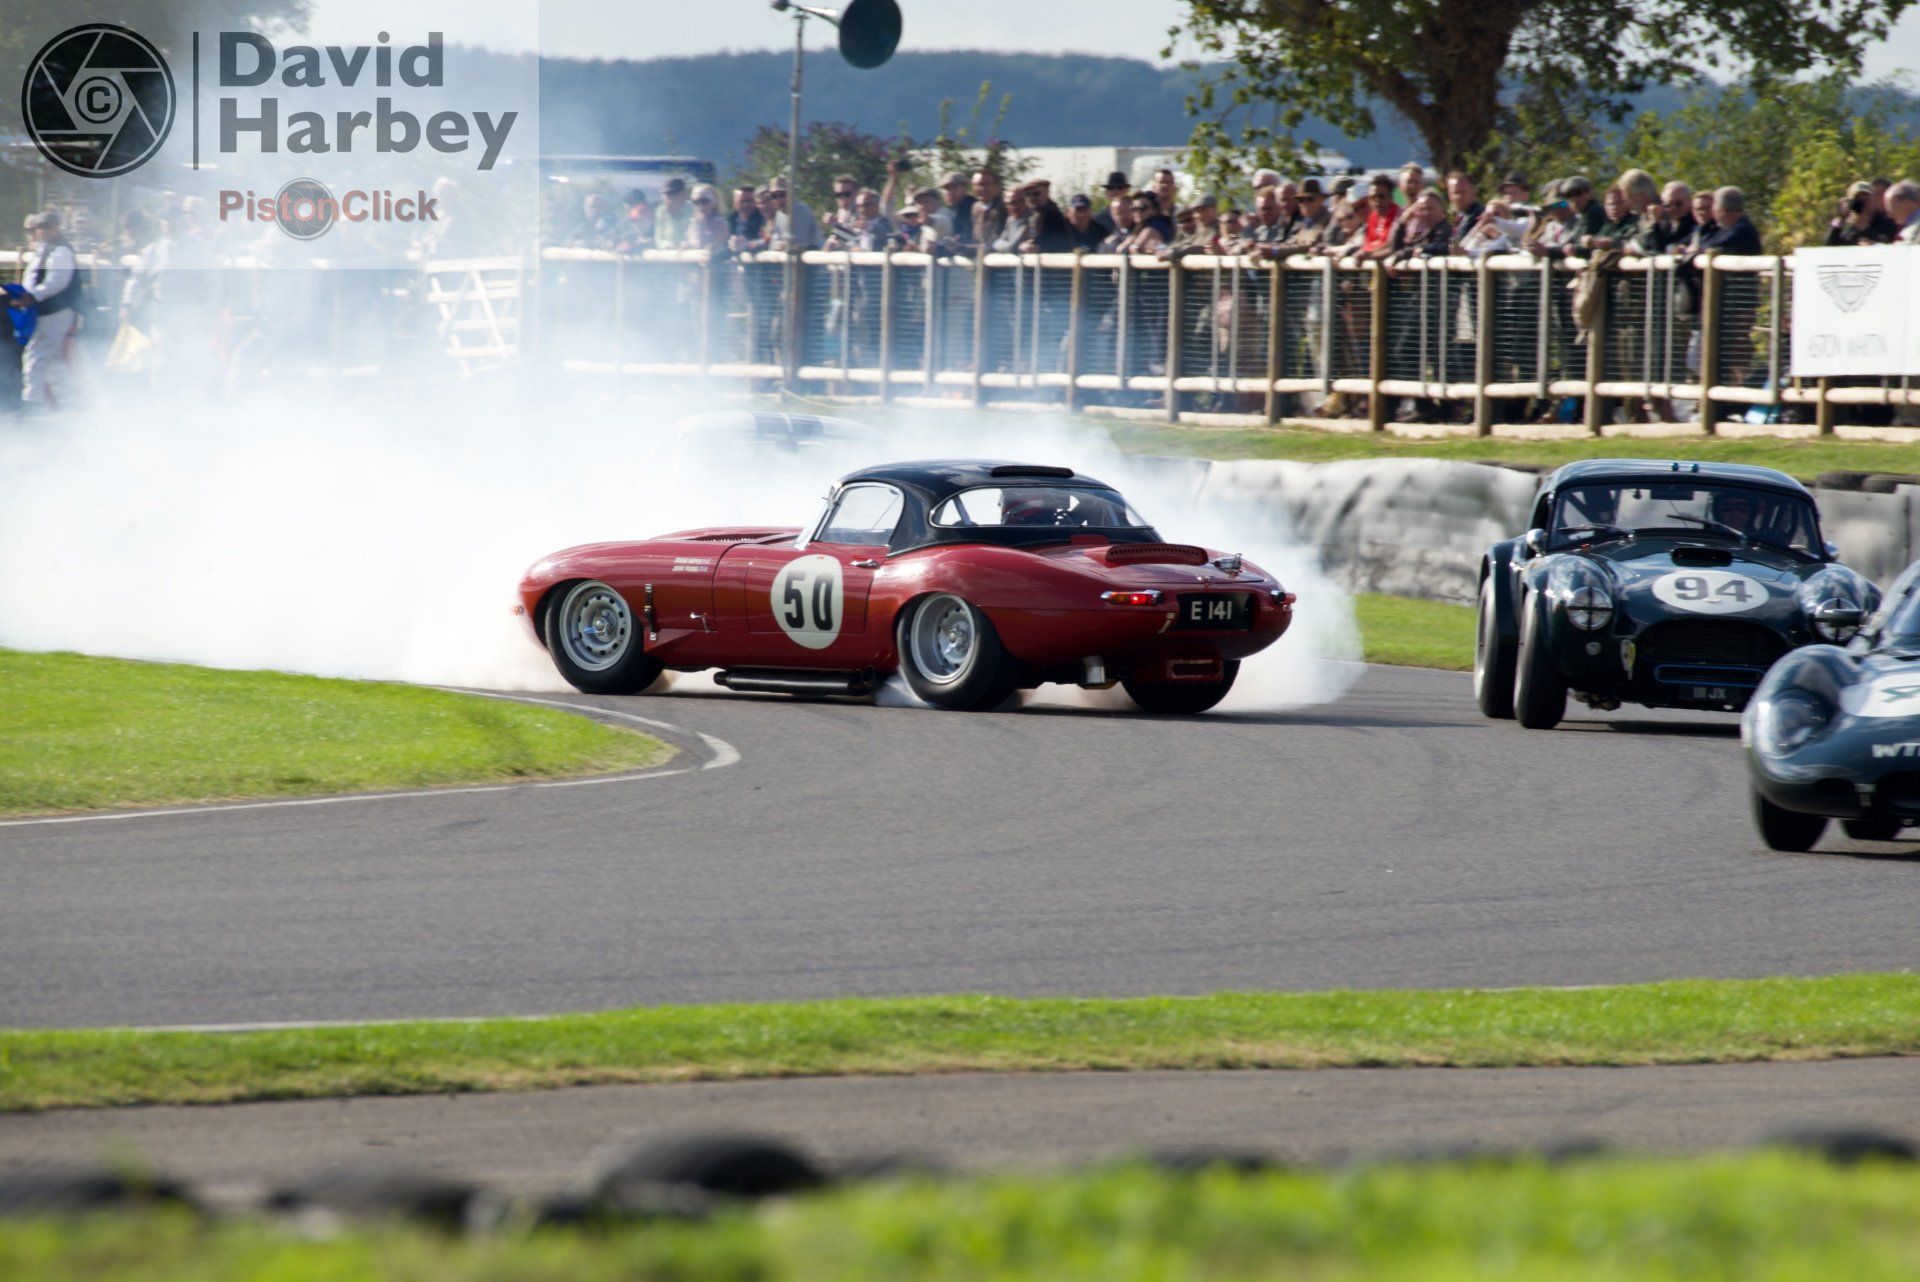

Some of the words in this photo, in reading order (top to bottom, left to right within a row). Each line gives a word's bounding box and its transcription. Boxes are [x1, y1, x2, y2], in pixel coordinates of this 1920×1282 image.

[784, 570, 834, 631] 50
[1674, 576, 1753, 603] 94
[1191, 600, 1202, 620] E
[1208, 600, 1232, 620] 141
